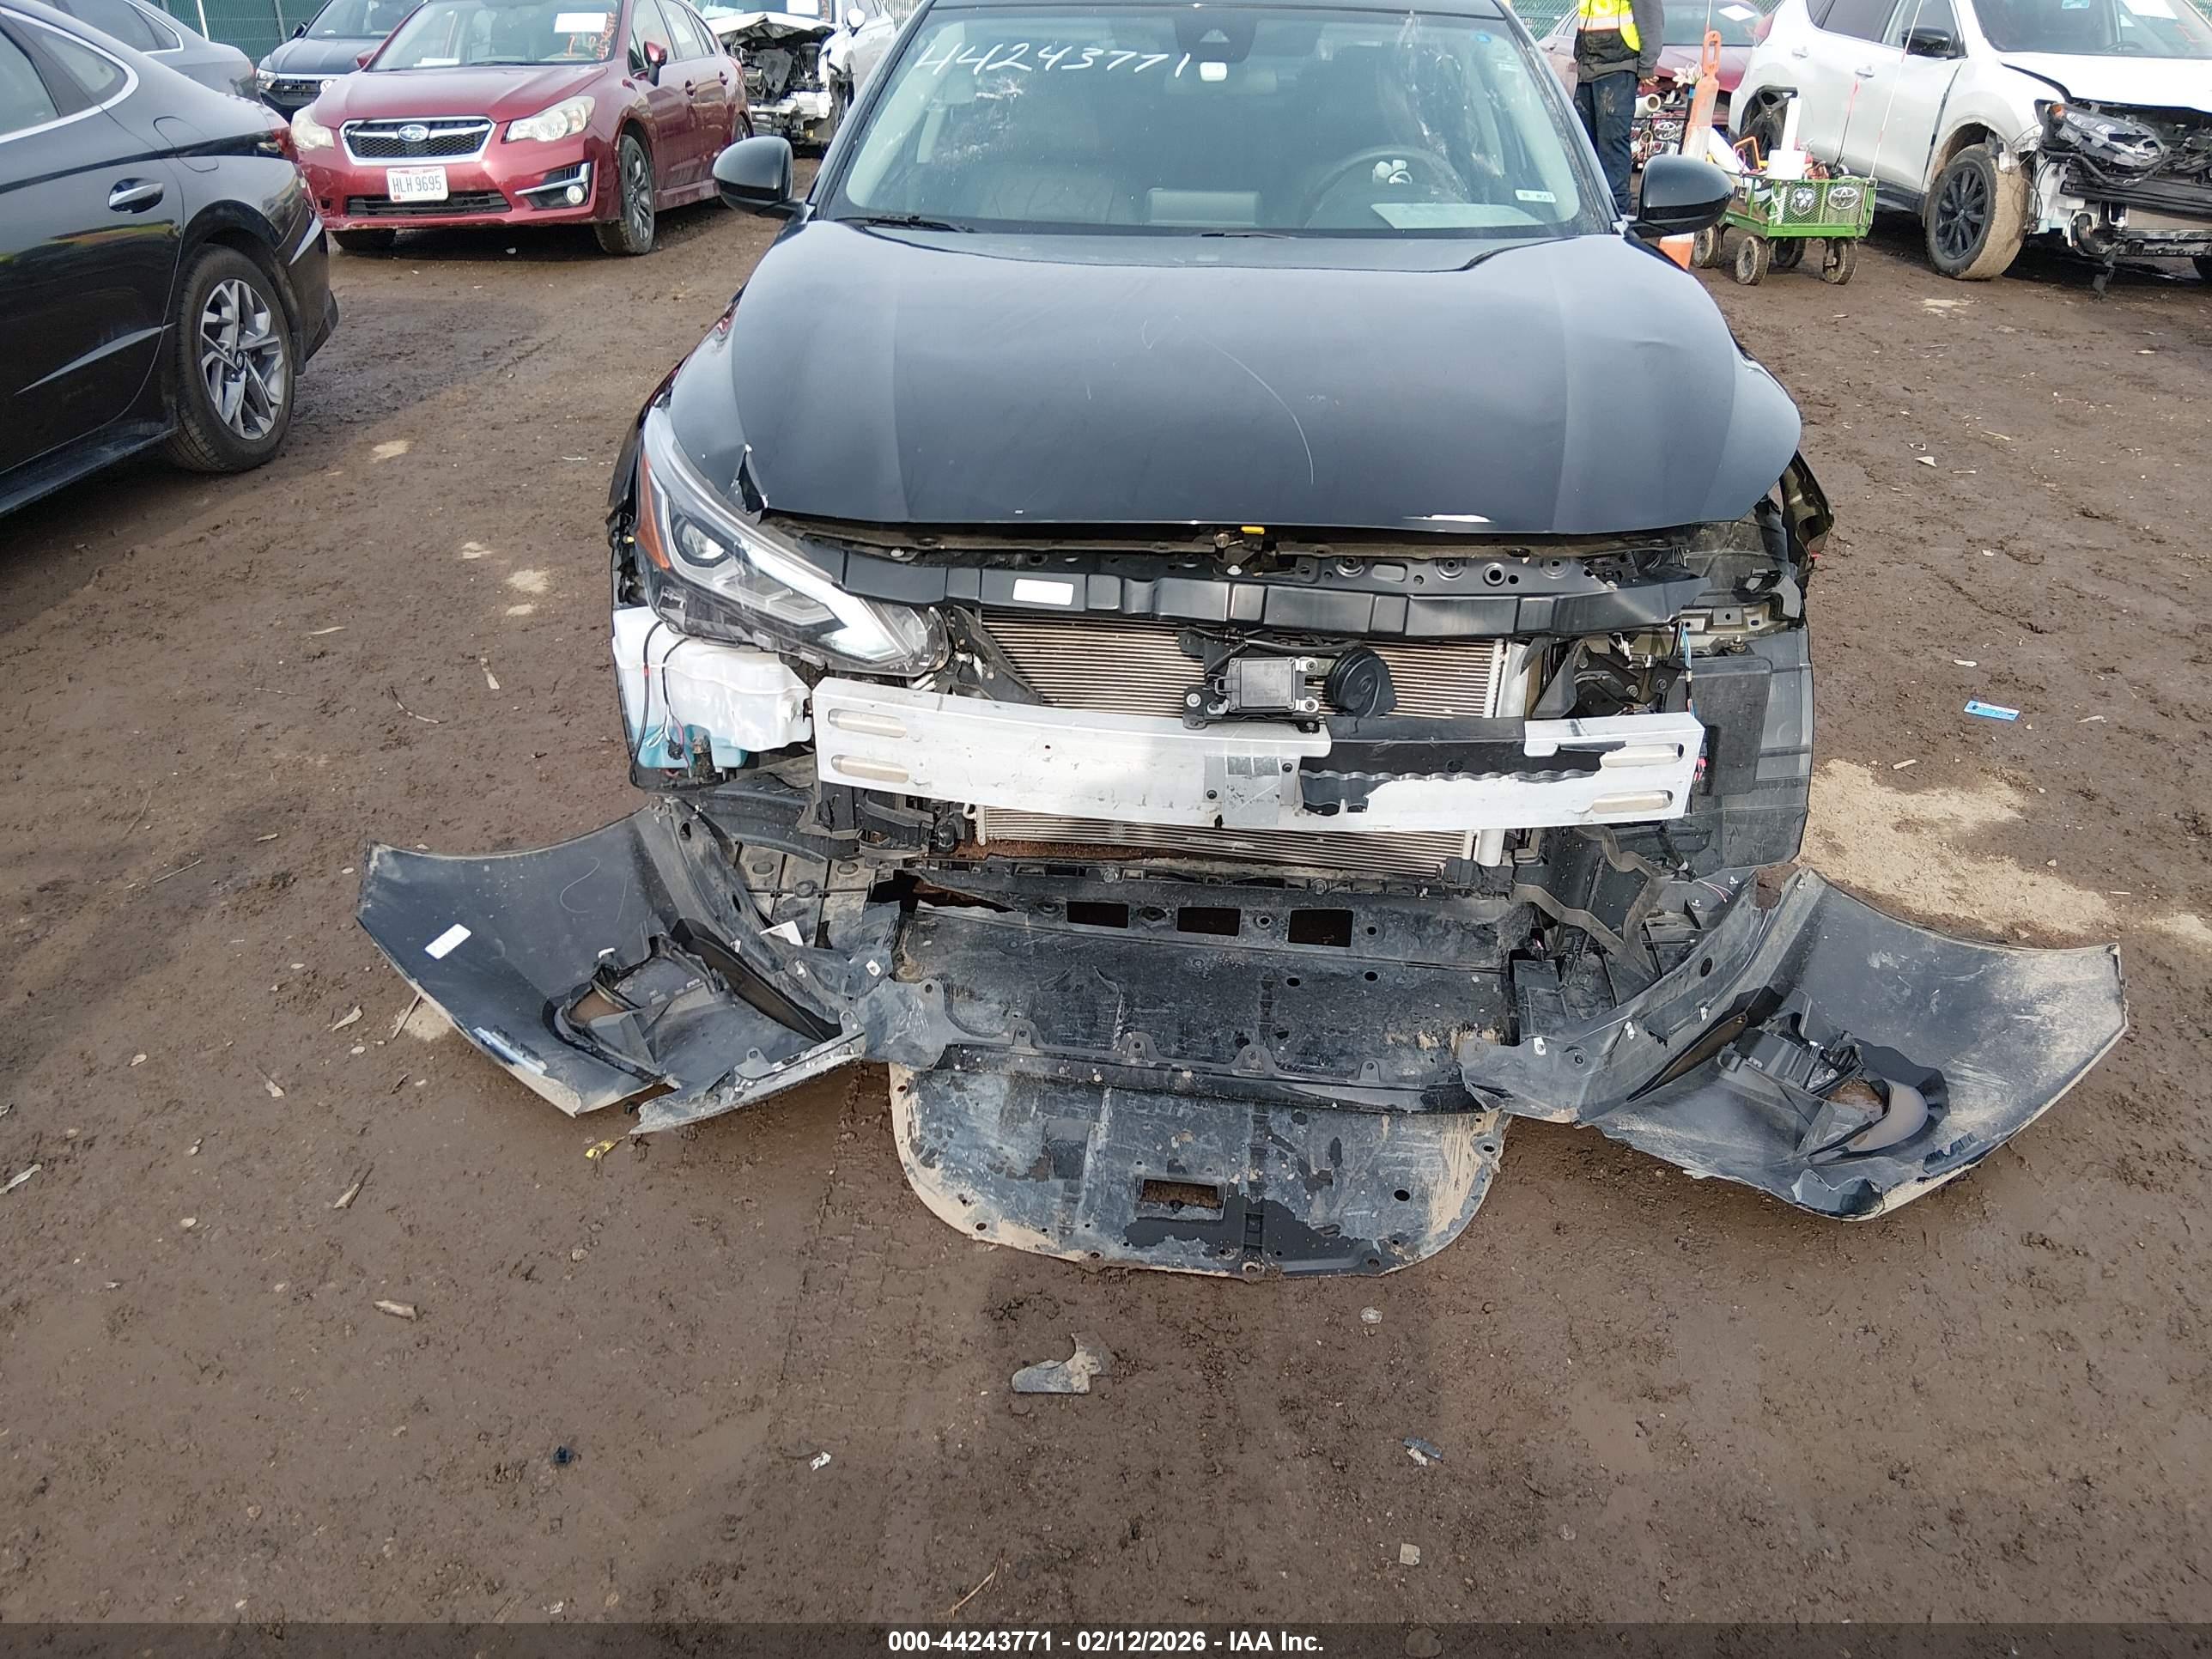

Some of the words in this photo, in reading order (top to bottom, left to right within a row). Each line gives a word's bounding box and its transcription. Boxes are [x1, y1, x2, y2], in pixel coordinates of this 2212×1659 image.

[915, 42, 1191, 77] 44243771
[392, 177, 412, 193] HLH
[416, 175, 441, 191] 9695
